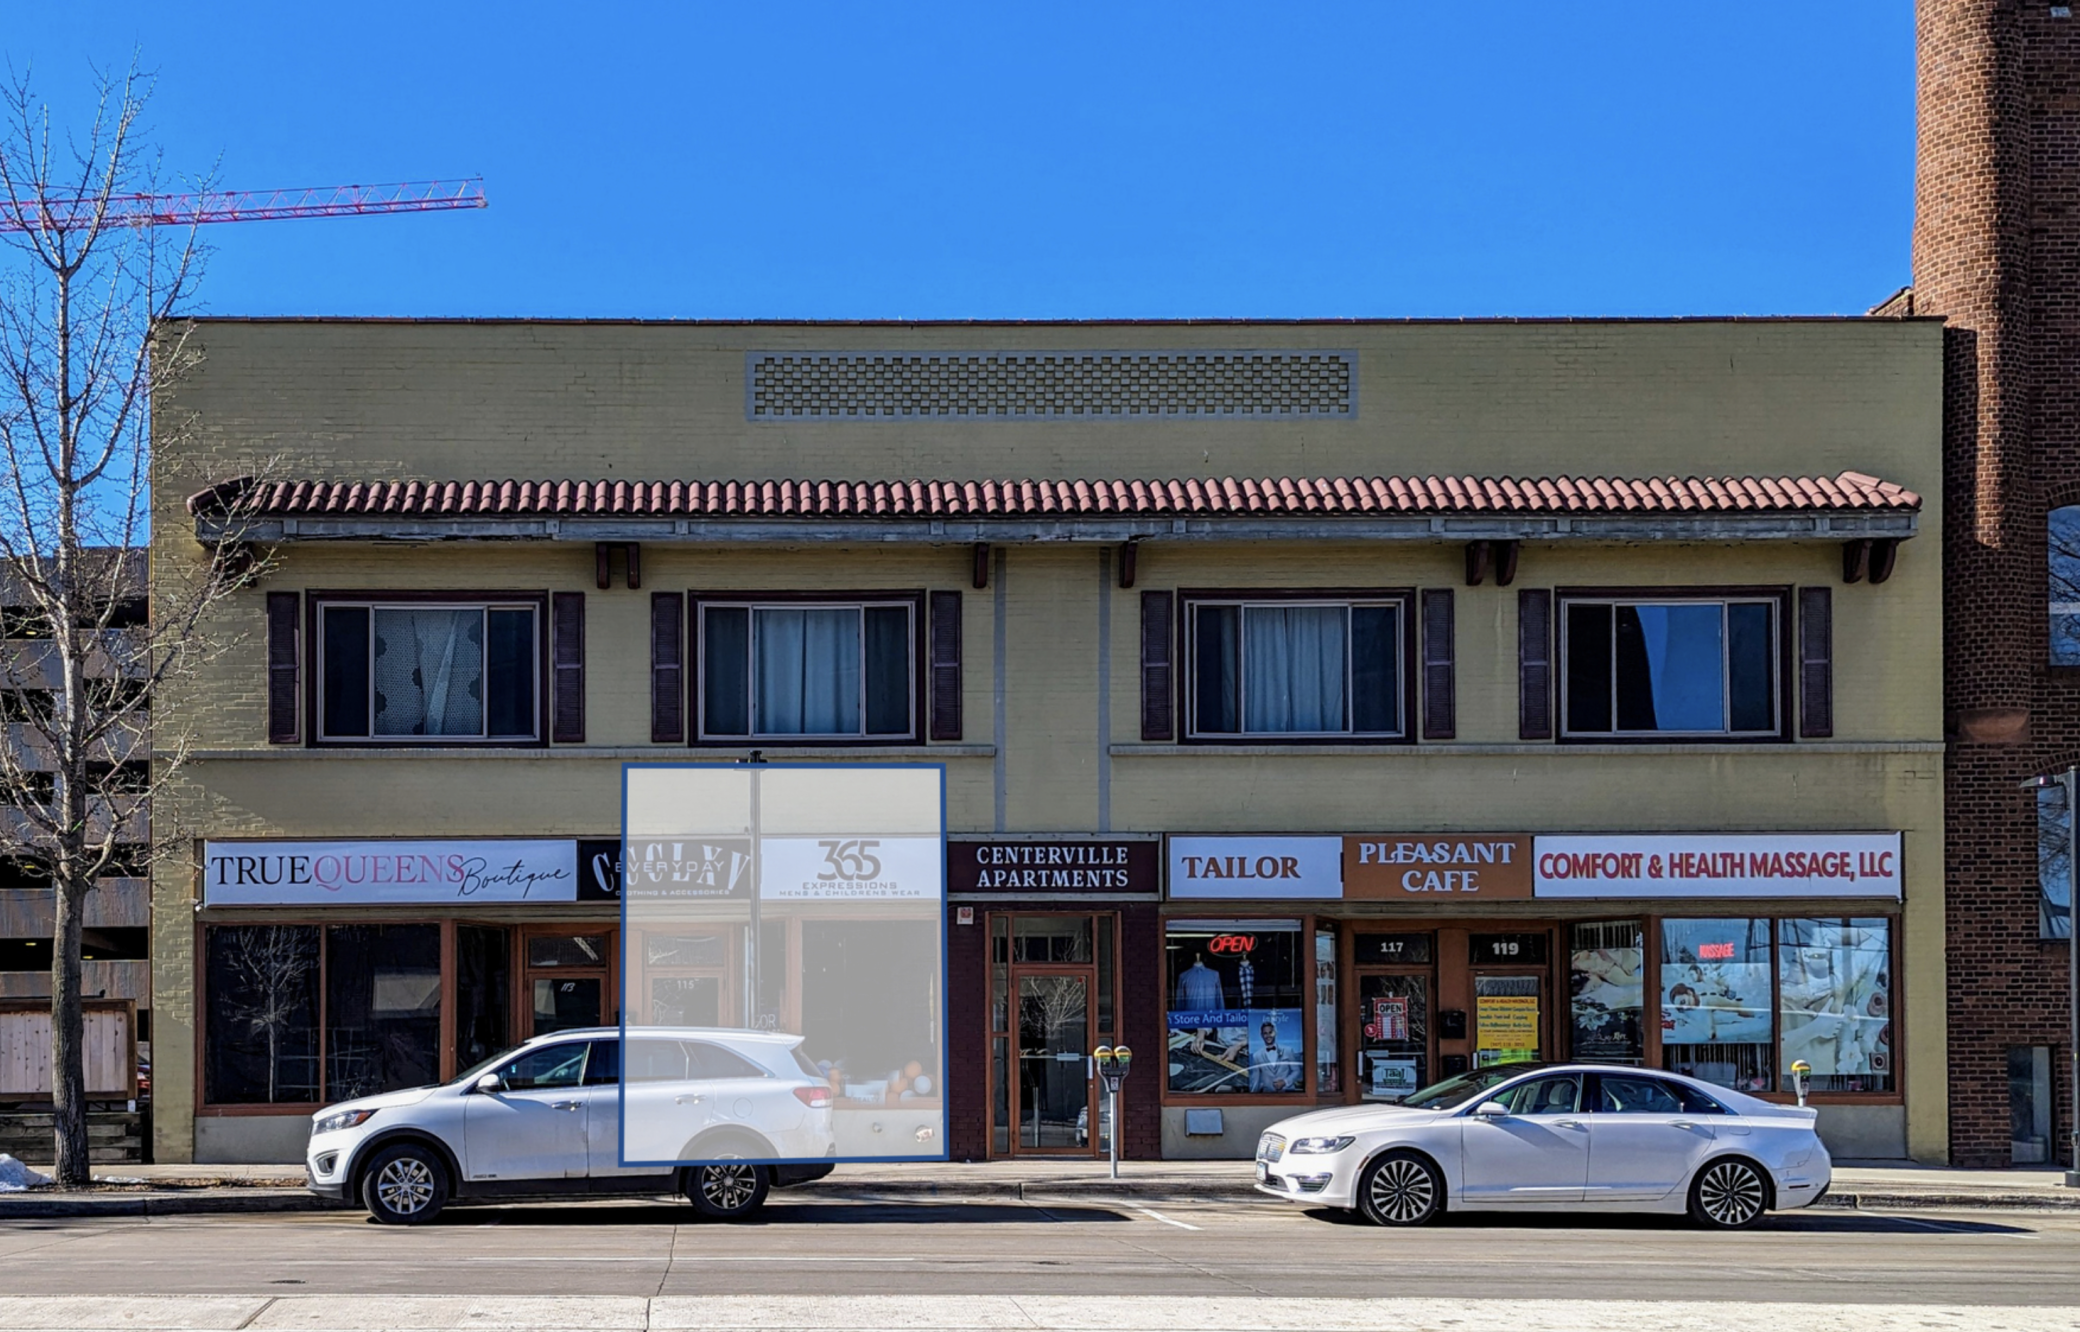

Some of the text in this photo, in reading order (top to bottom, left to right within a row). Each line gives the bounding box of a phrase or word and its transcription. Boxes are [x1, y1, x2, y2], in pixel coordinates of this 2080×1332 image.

[817, 840, 881, 881] 365
[976, 846, 1128, 864] CENTERVILLE
[1358, 842, 1516, 864] PLEASANT
[615, 861, 724, 873] EVERYDAY
[1181, 856, 1302, 879] TAILOR
[1539, 851, 1893, 882] COMFORT & HEALTH MASSAGE, LLC
[453, 857, 570, 899] Boutique
[802, 881, 897, 890] EXPRESSIONS
[976, 869, 1129, 887] APARTMENTS
[1401, 869, 1479, 892] CAFE
[615, 889, 658, 897] COTHING
[1209, 935, 1255, 953] OPEN
[1380, 942, 1404, 953] 117
[1492, 942, 1519, 955] 119
[560, 982, 576, 993] 113
[677, 980, 695, 990] 115
[1379, 1004, 1402, 1013] OPEN
[1174, 1014, 1200, 1024] Store
[1202, 1013, 1223, 1024] And
